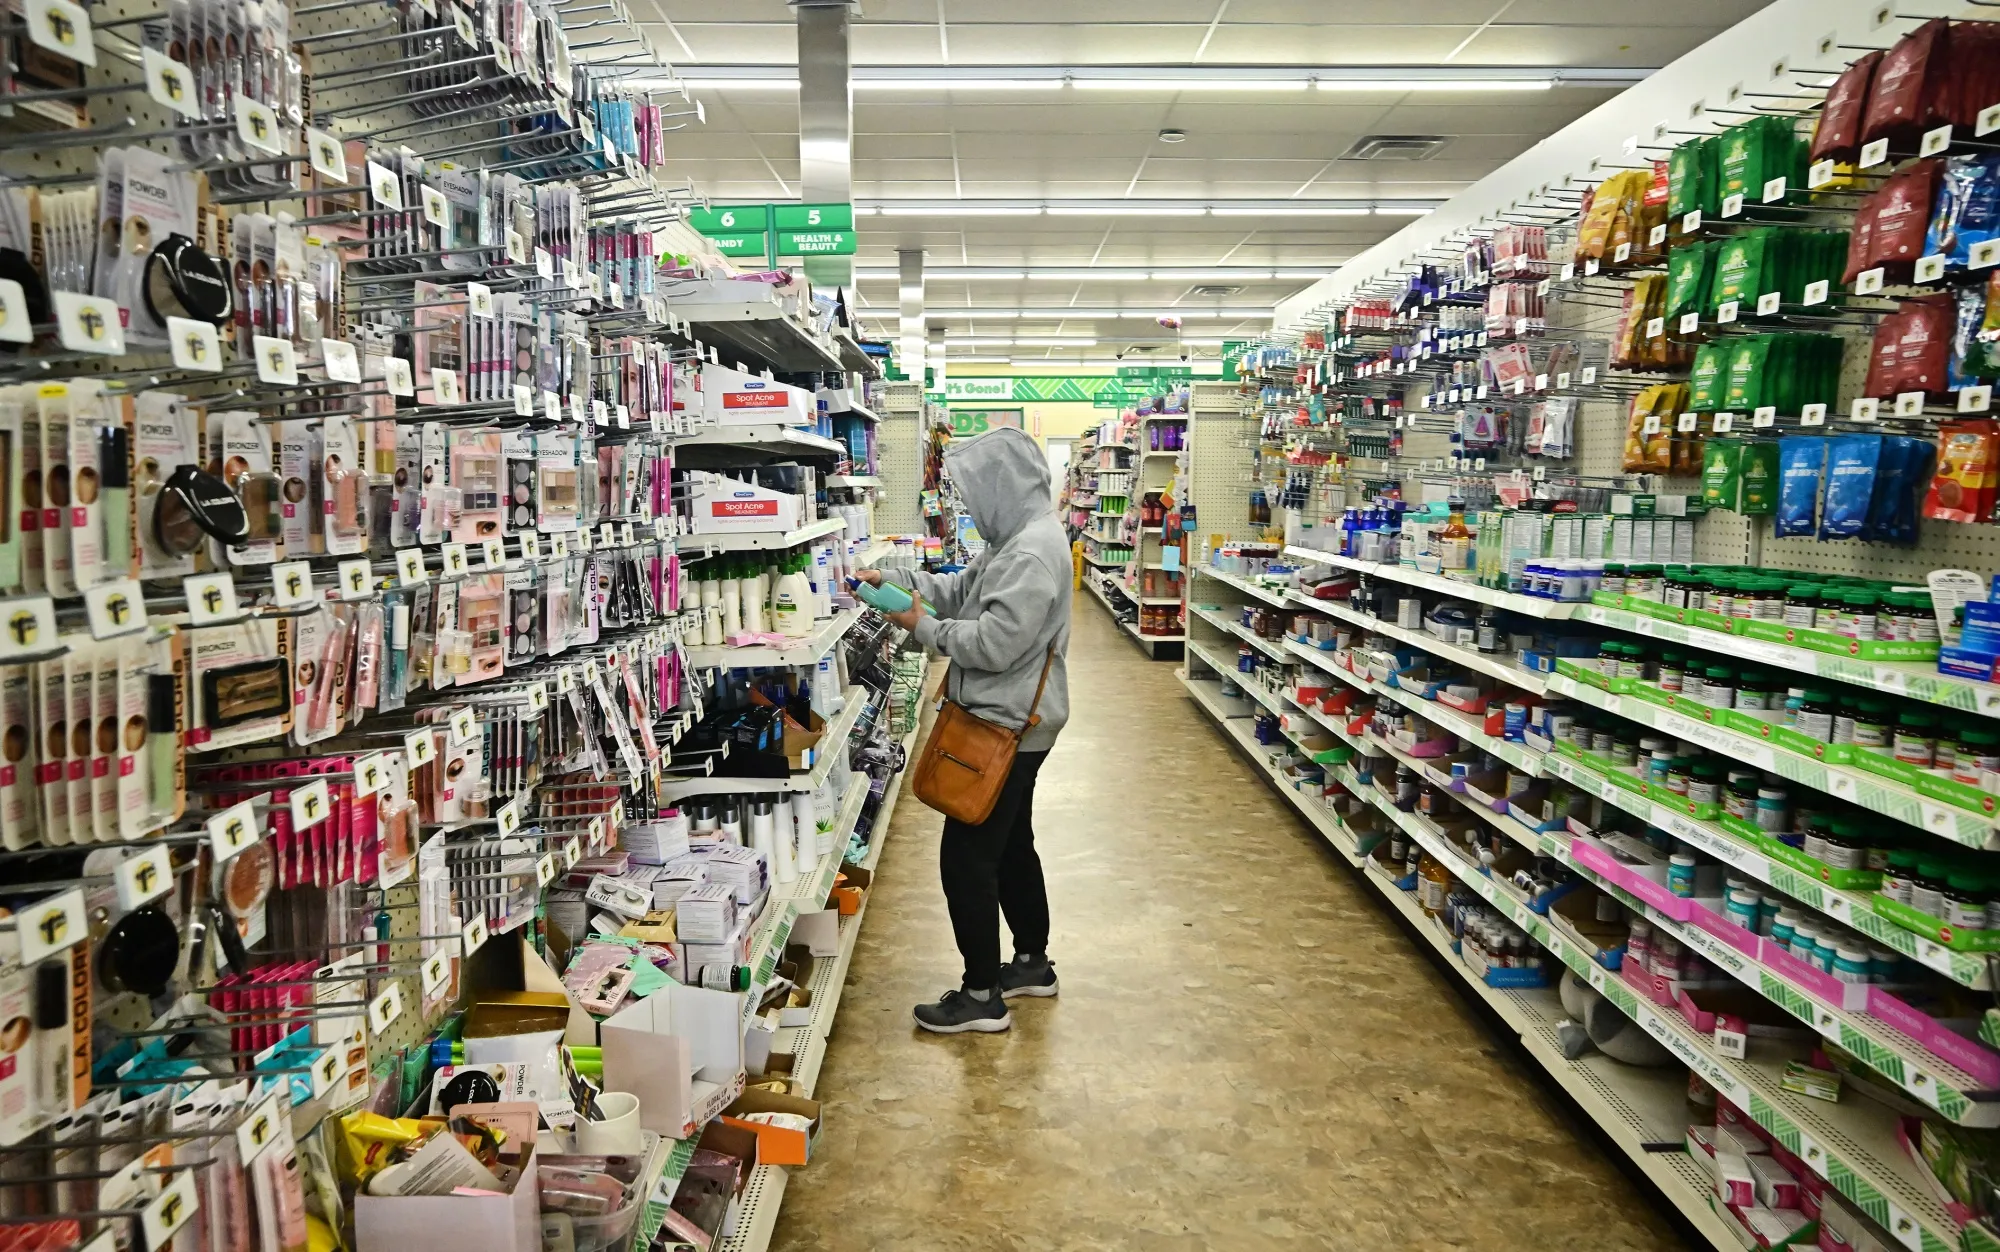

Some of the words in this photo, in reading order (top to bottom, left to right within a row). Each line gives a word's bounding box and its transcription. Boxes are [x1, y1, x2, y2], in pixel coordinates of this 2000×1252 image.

[129, 179, 168, 200] POWDER
[443, 180, 473, 196] EYESHADOW
[720, 211, 735, 227] 6
[807, 209, 821, 225] 5
[715, 239, 744, 248] ANDY
[792, 234, 827, 243] HEALTH
[831, 234, 843, 243] &
[798, 242, 838, 251] BEAUTY
[1127, 368, 1140, 376] 13
[965, 381, 1006, 394] Gone!
[736, 394, 753, 403] Spot
[141, 424, 173, 436] POWDER
[950, 413, 989, 433] DS
[227, 442, 259, 450] BRONZER
[283, 444, 304, 452] STICK
[725, 503, 743, 511] Spot
[197, 641, 236, 654] BRONZER
[482, 733, 491, 776] OLORS
[1687, 927, 1707, 945] Value
[1707, 939, 1745, 972] Everyday
[75, 1037, 88, 1079] L.A.
[1648, 1018, 1666, 1037] Grab
[1672, 1036, 1696, 1061] Before
[1709, 1064, 1737, 1091] Gone!
[516, 1064, 525, 1096] POWDER
[703, 1105, 717, 1120] GLOSS
[720, 1094, 731, 1108] BALM
[706, 1094, 721, 1109] FLORAL
